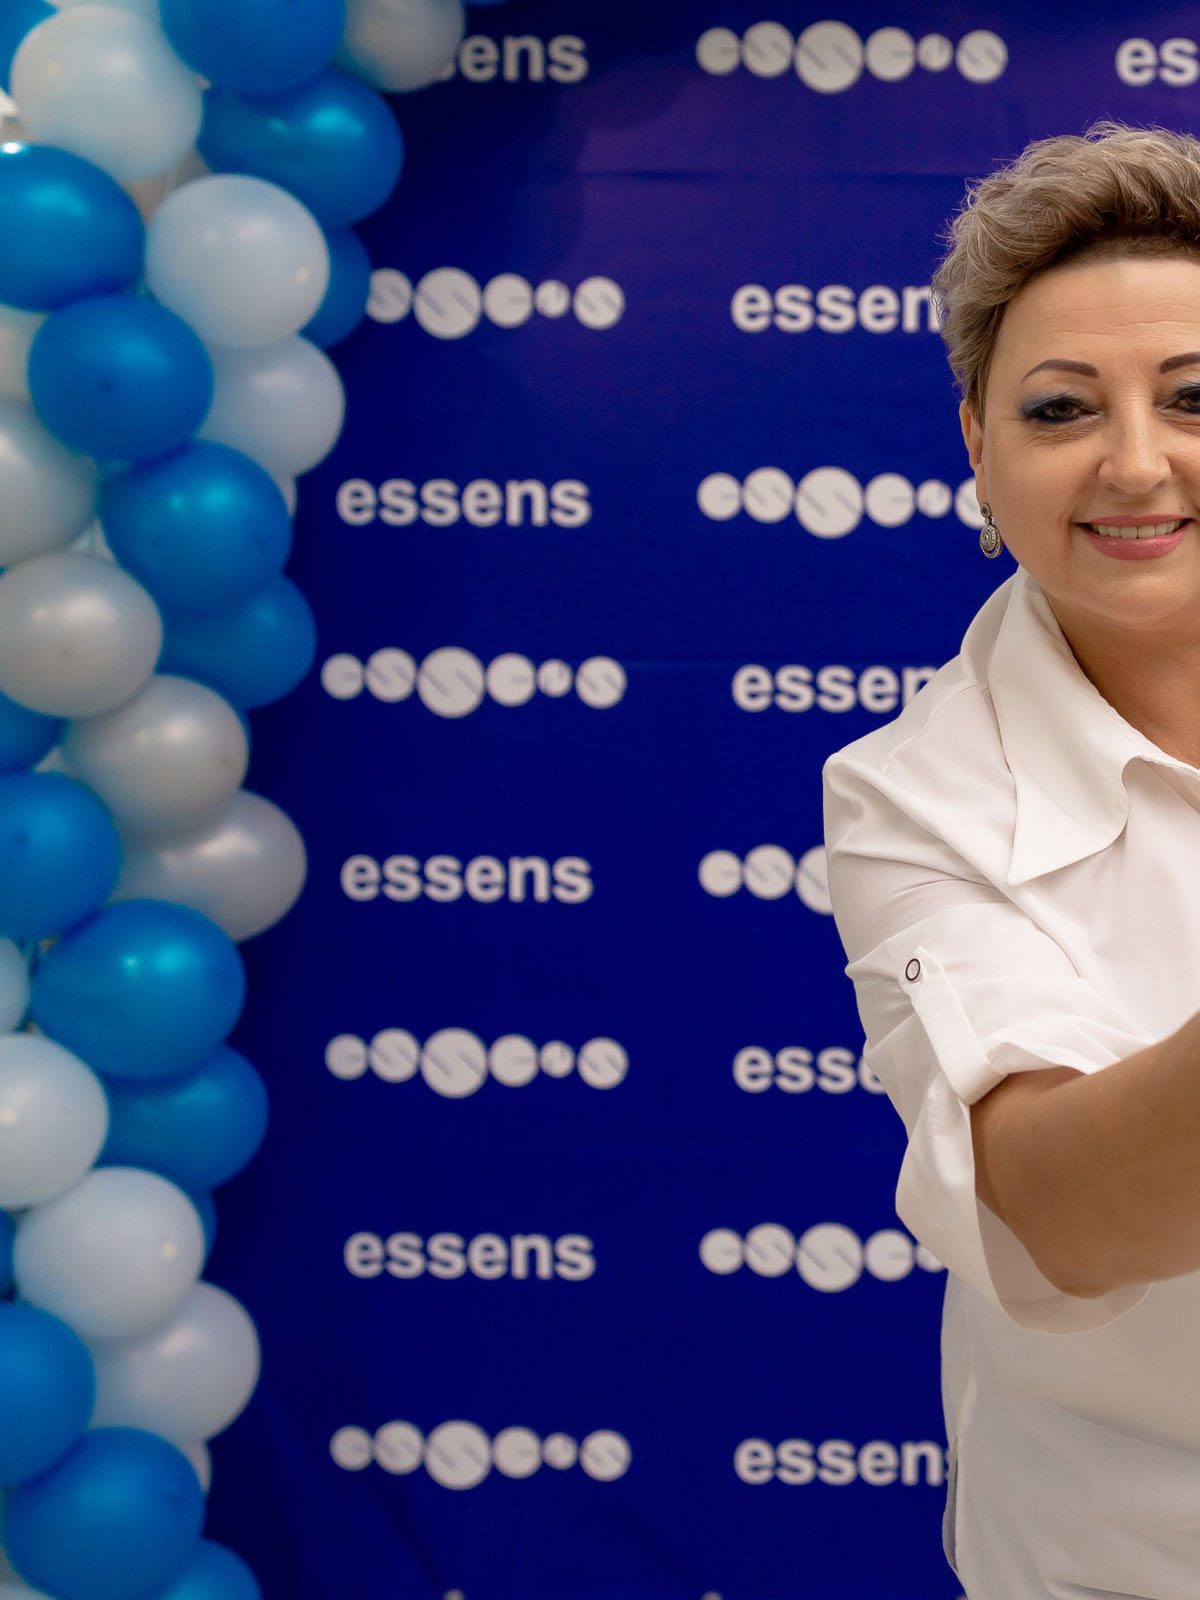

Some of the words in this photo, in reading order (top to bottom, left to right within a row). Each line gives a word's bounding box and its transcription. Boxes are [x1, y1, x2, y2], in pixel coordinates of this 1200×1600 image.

[731, 284, 941, 333] essen
[338, 478, 590, 527] essens
[731, 664, 938, 713] essen
[342, 854, 592, 903] essens
[345, 1232, 594, 1280] essens
[734, 1438, 949, 1485] essen
